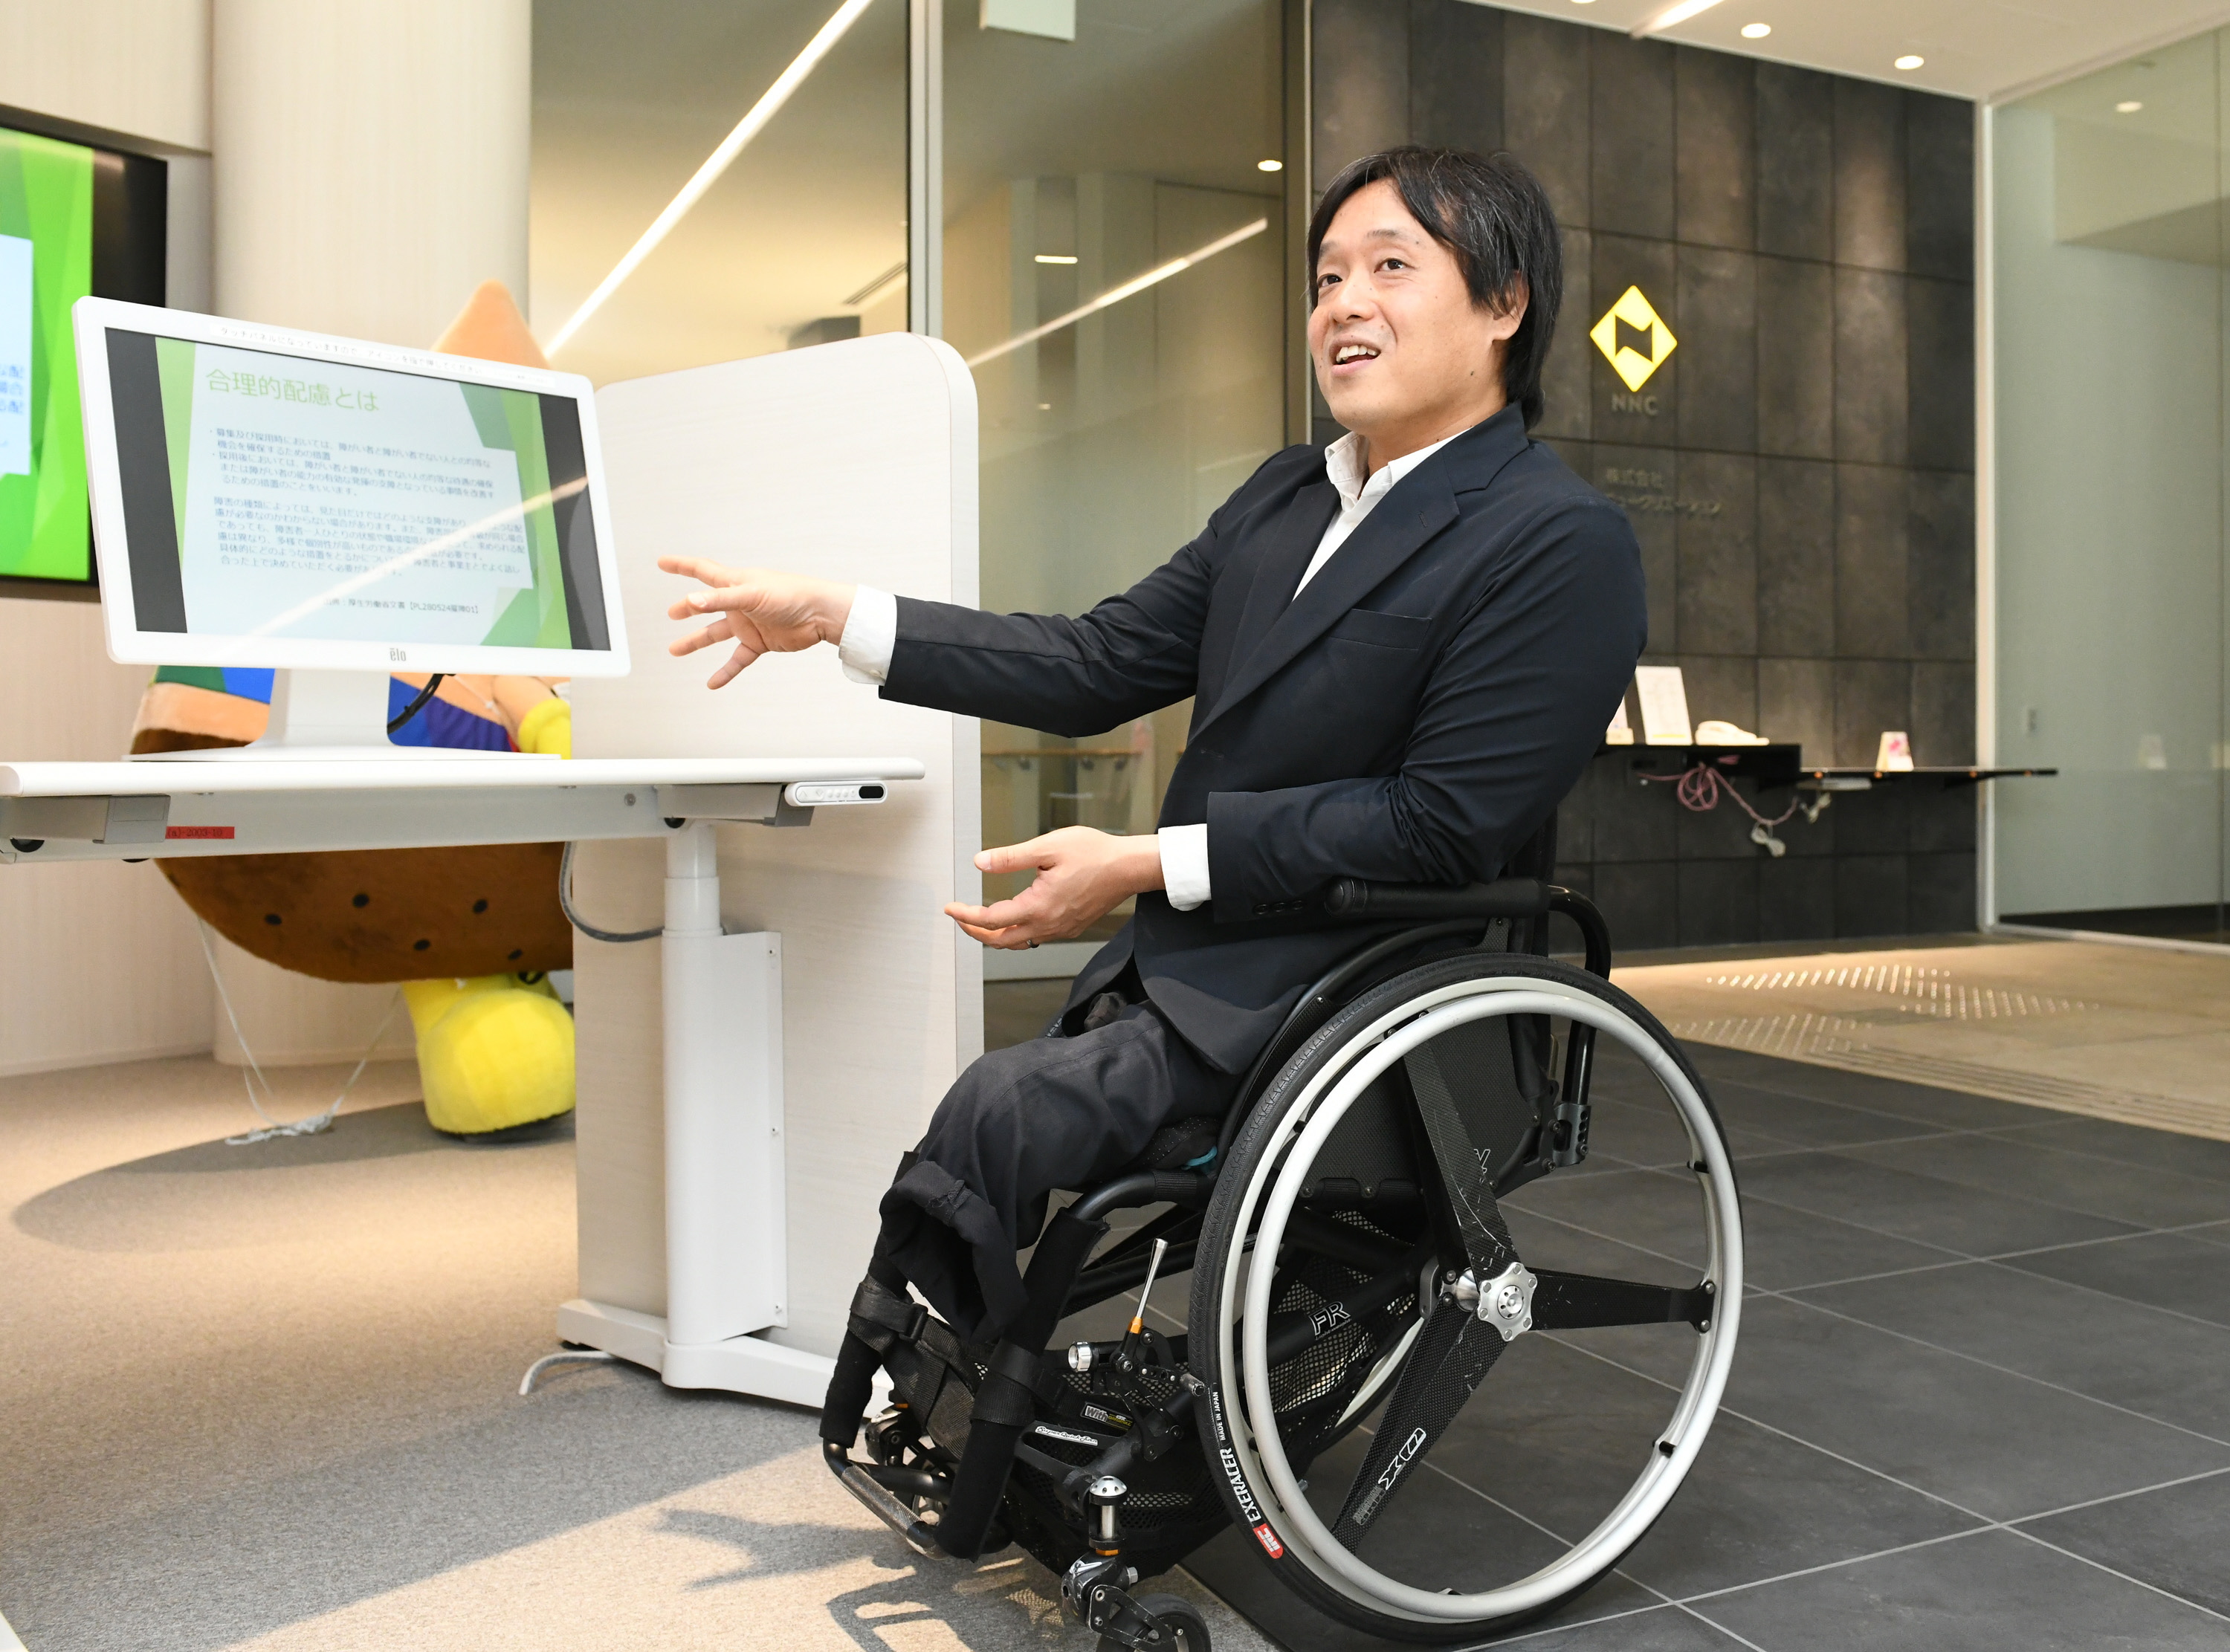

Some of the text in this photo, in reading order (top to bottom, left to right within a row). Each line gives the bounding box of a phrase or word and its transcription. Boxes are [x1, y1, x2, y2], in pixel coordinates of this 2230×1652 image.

[206, 369, 380, 411] 合理的配慮とは
[1612, 394, 1658, 415] NNC
[1308, 1301, 1351, 1336] FR
[1086, 1407, 1108, 1422] With
[1212, 1391, 1226, 1440] MADE IN JAPAN
[1037, 1427, 1060, 1436] Super
[1061, 1432, 1079, 1440] Quick
[1220, 1448, 1261, 1523] EXERACER
